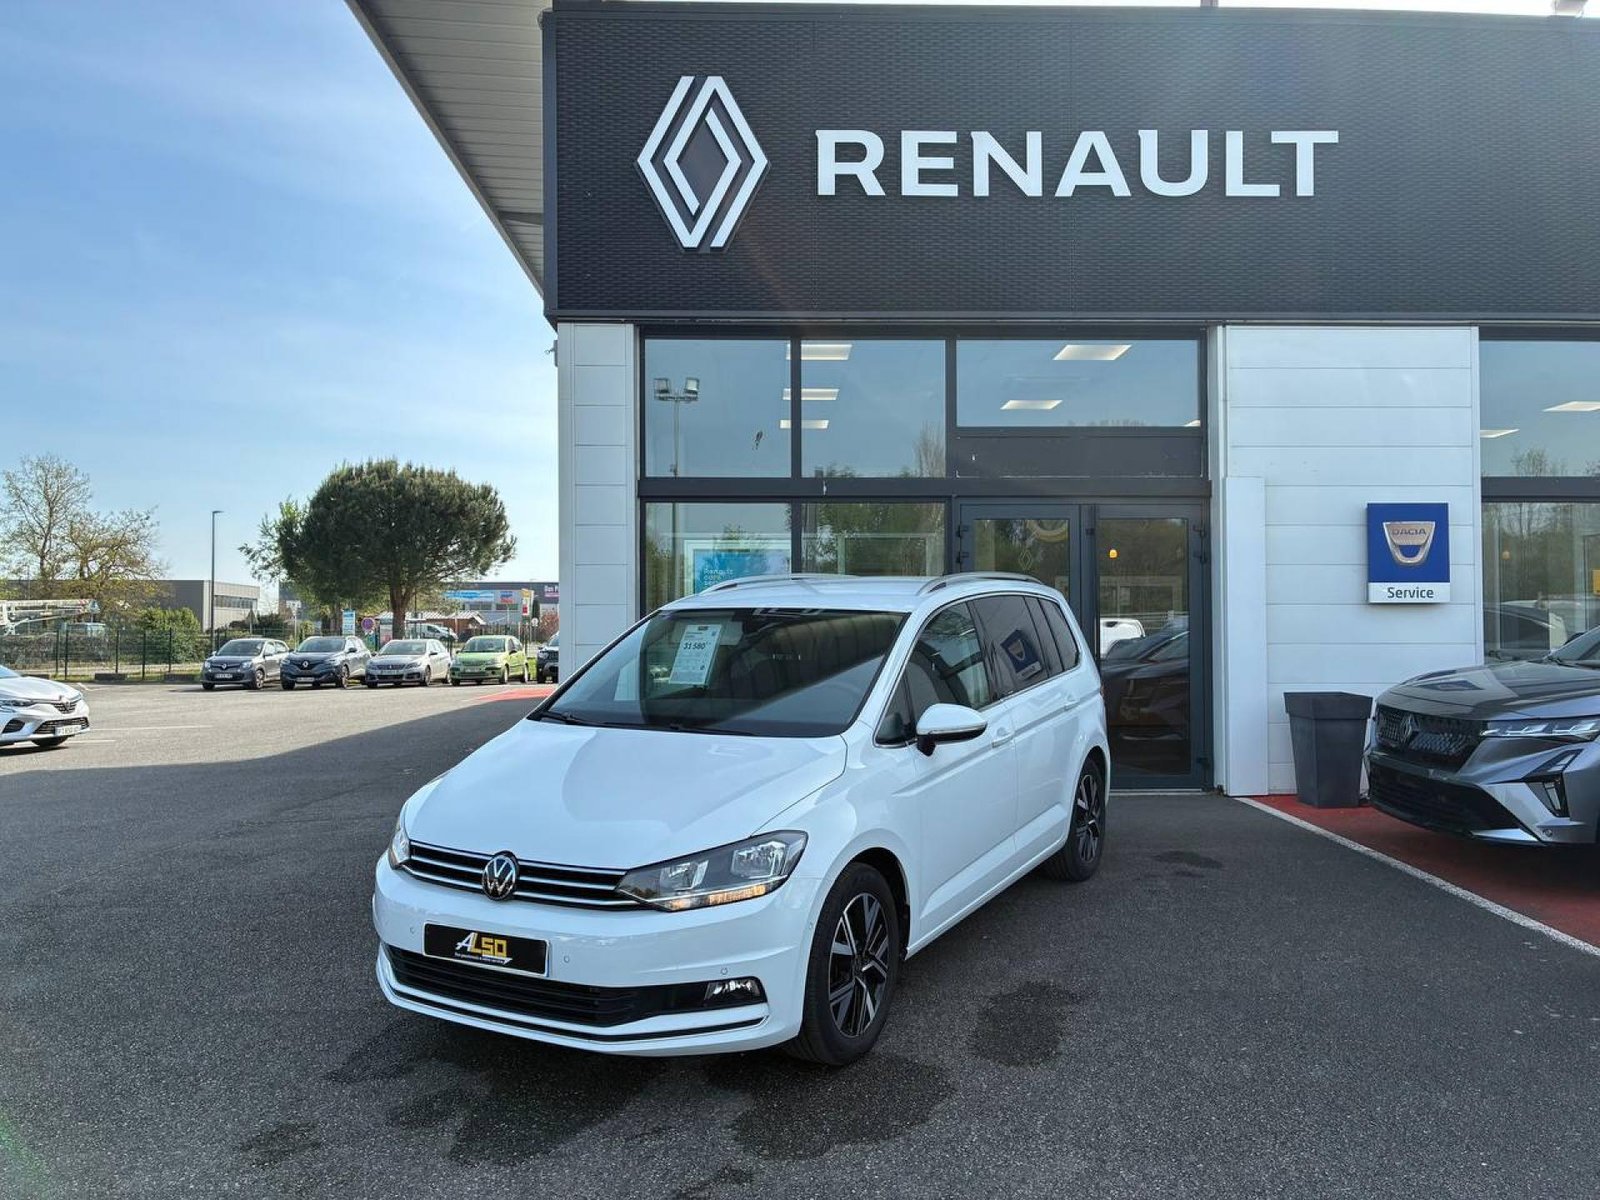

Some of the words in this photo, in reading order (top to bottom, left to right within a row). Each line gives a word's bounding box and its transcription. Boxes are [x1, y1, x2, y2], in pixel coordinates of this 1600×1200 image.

[815, 129, 1339, 197] RENAULT
[1391, 528, 1426, 536] DACIA
[1387, 586, 1434, 599] Service
